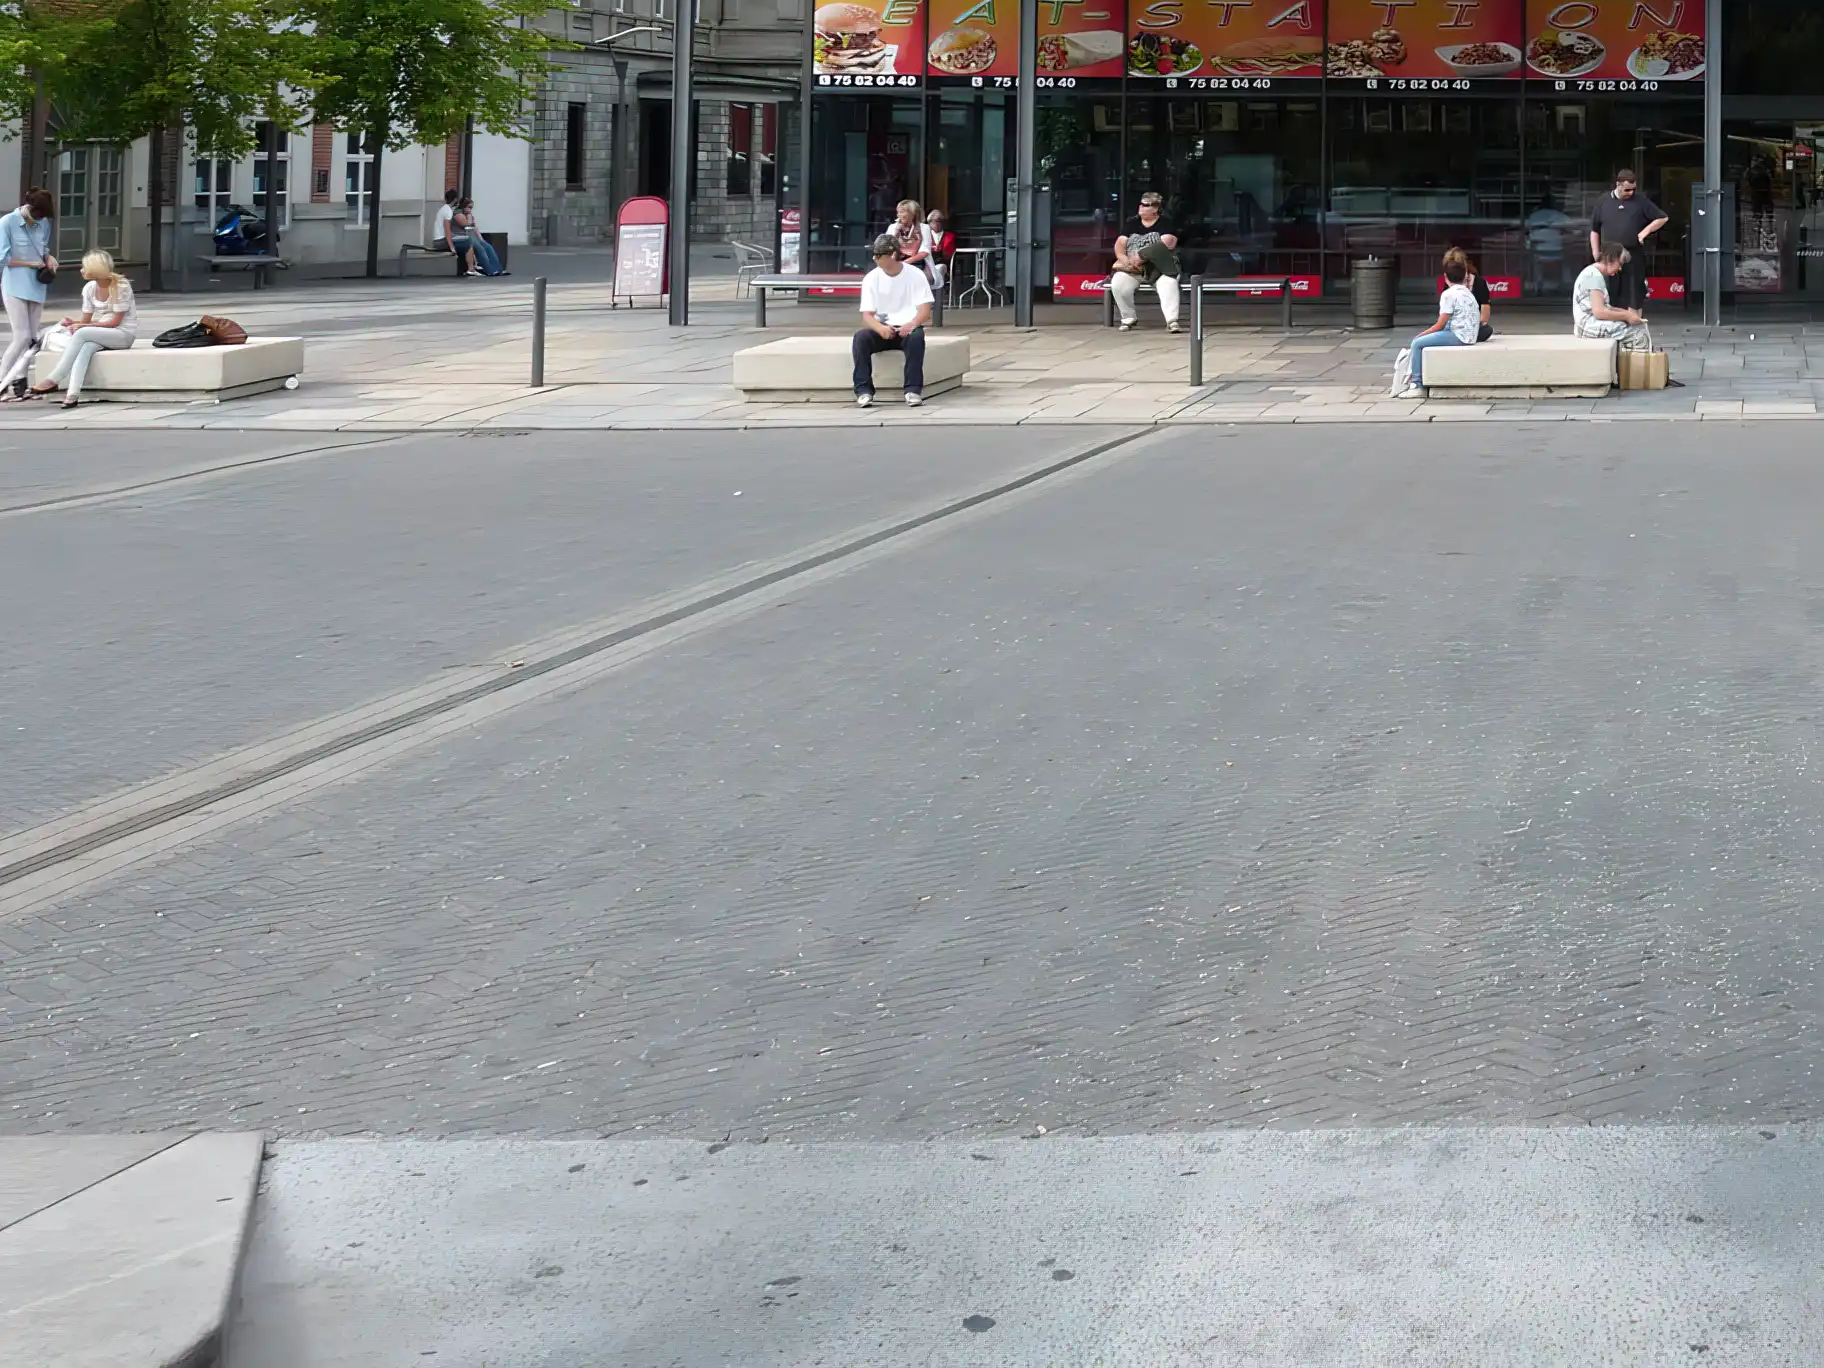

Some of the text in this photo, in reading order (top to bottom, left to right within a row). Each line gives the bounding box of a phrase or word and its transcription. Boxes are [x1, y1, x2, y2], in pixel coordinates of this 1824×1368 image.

[834, 75, 852, 85] 75
[876, 75, 895, 86] 04
[898, 75, 916, 86] 40
[994, 77, 1012, 87] 75
[1036, 77, 1054, 88] 04
[1057, 77, 1076, 88] 40
[1188, 78, 1206, 88] 75
[1231, 78, 1249, 88] 04
[1252, 78, 1271, 88] 40
[1389, 79, 1406, 89] 75
[1431, 79, 1449, 89] 04
[1452, 79, 1470, 89] 40
[1577, 80, 1594, 91] 75
[1619, 80, 1637, 91] 04
[1640, 80, 1658, 91] 40
